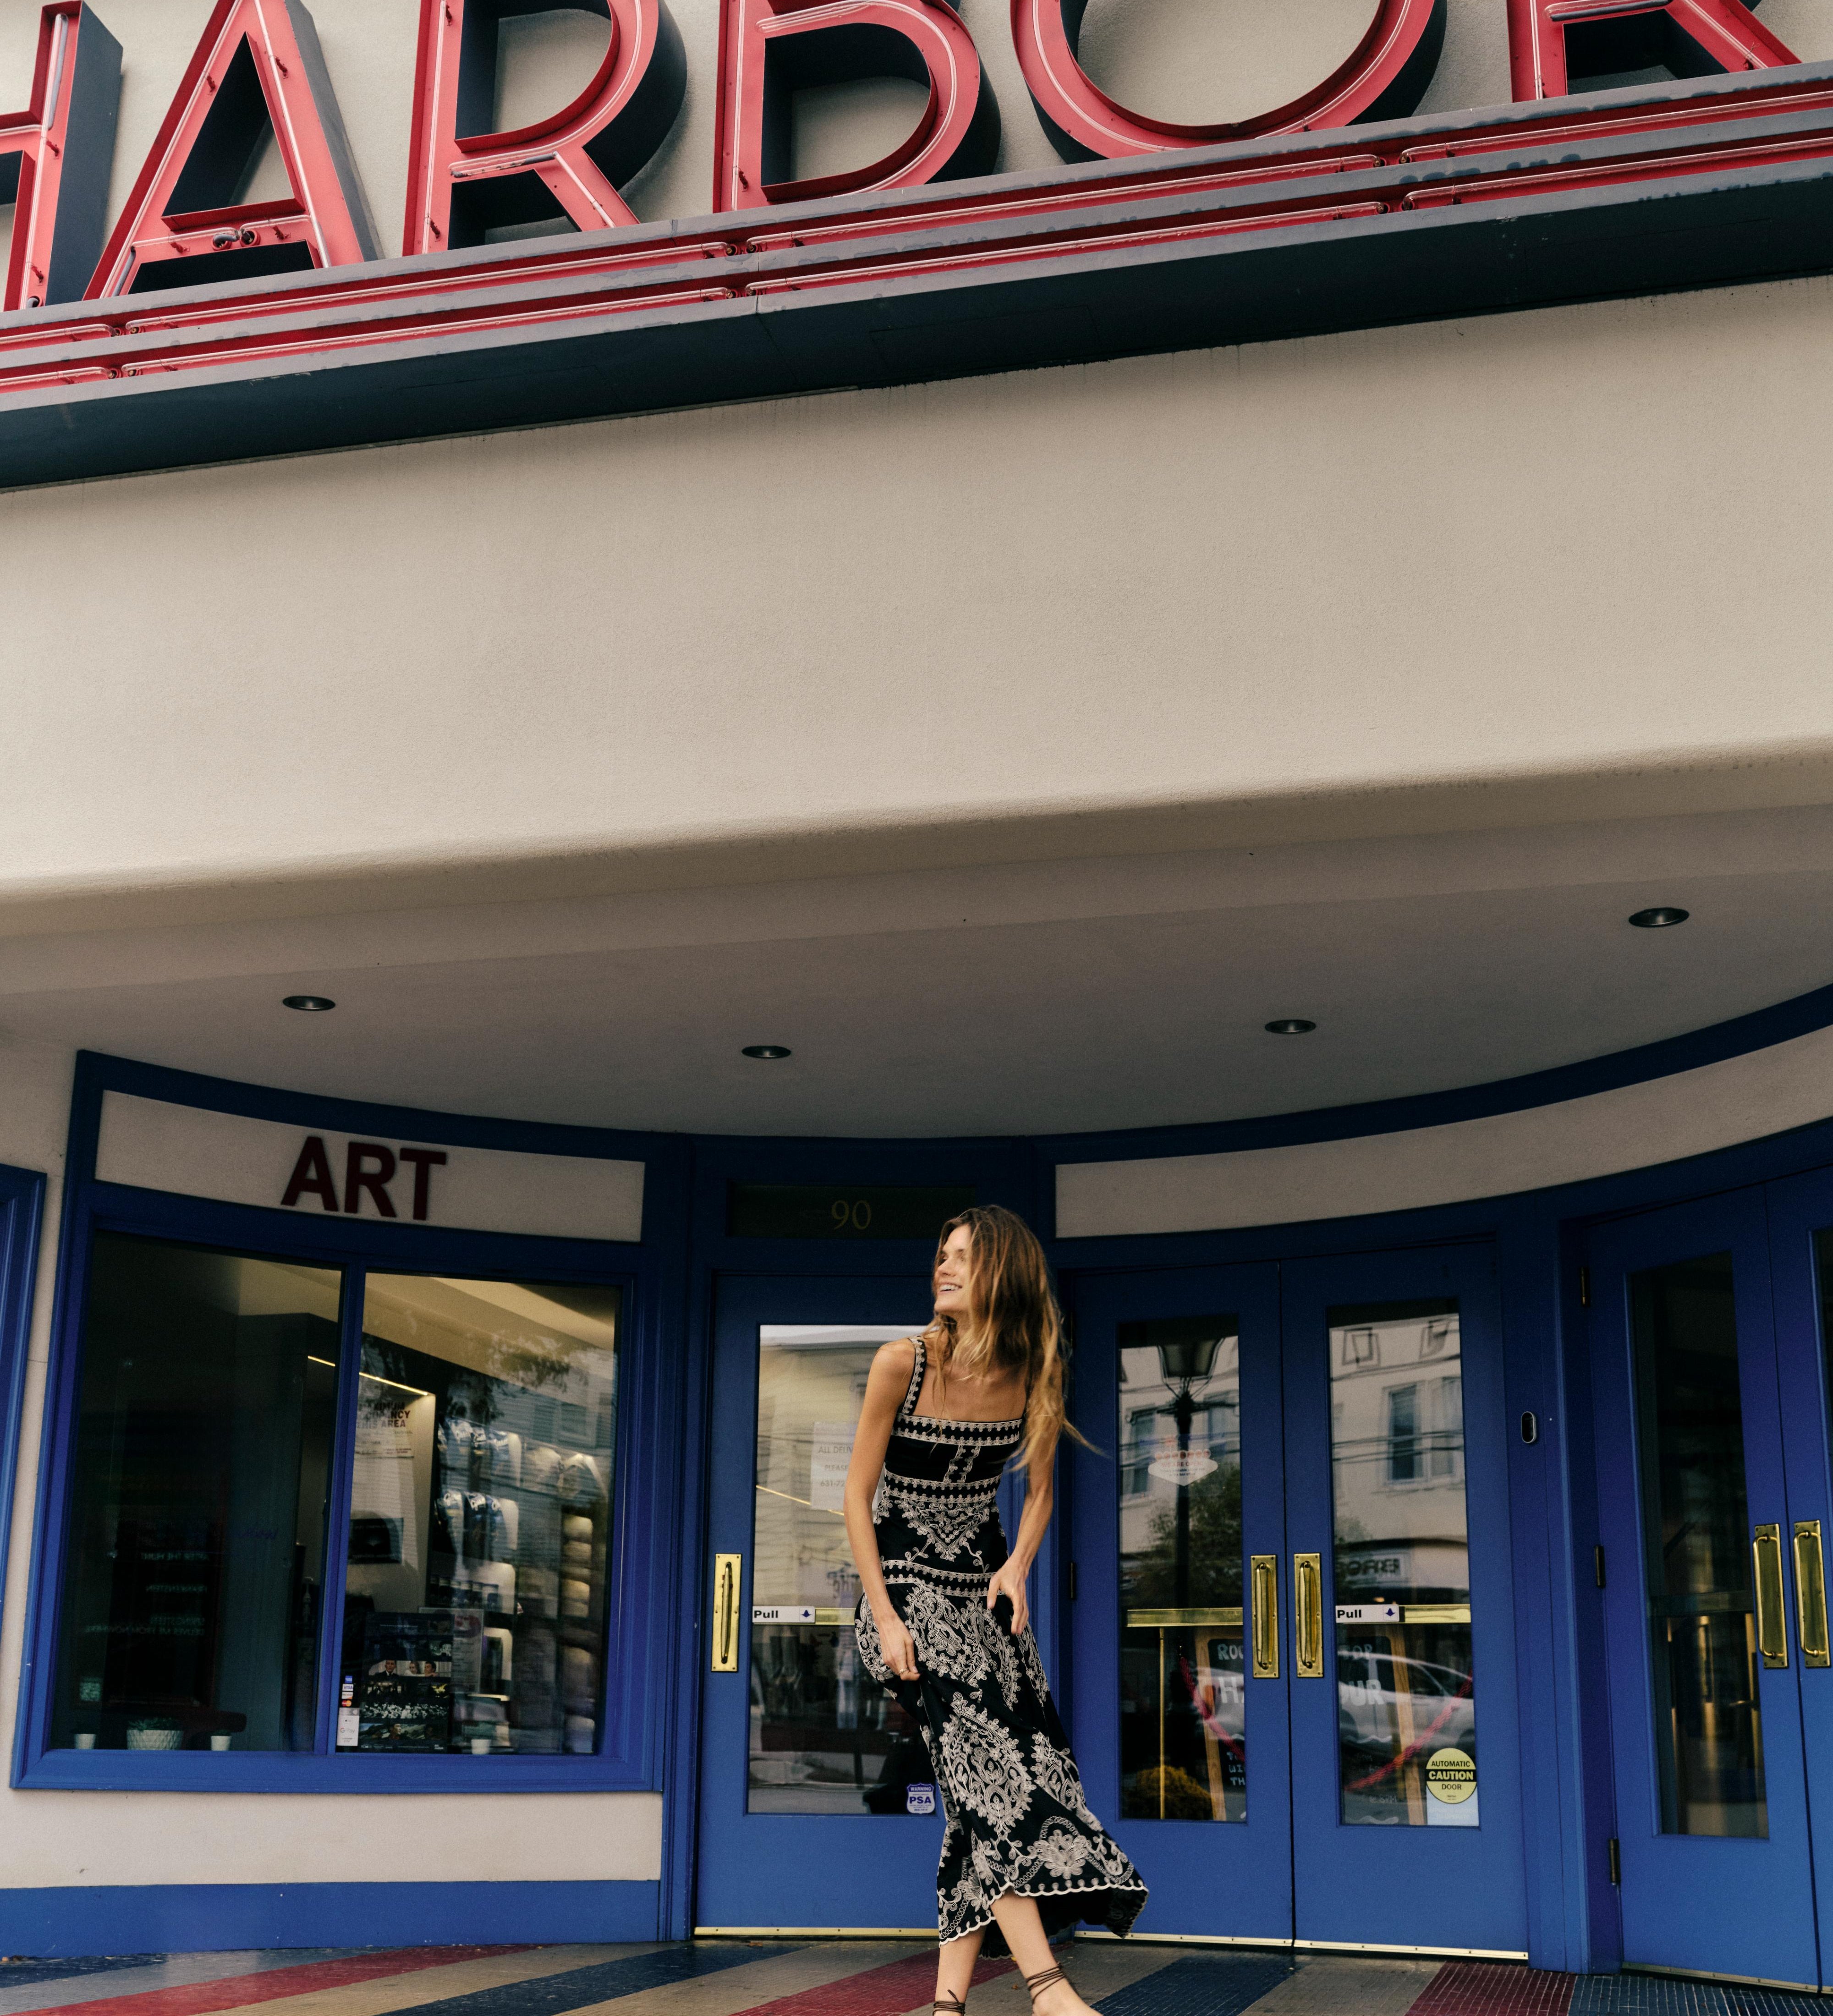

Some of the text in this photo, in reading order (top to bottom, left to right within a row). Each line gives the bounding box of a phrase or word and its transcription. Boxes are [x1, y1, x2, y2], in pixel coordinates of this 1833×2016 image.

[0, 0, 1802, 312] ARB
[280, 1136, 446, 1221] ART
[831, 1200, 872, 1230] 90
[358, 1402, 405, 1411] XIMUM
[381, 1419, 406, 1428] AREA
[754, 1610, 779, 1619] Pull
[1337, 1610, 1362, 1619] Pull
[1219, 1676, 1245, 1704] H
[1428, 1770, 1474, 1780] CAUTION
